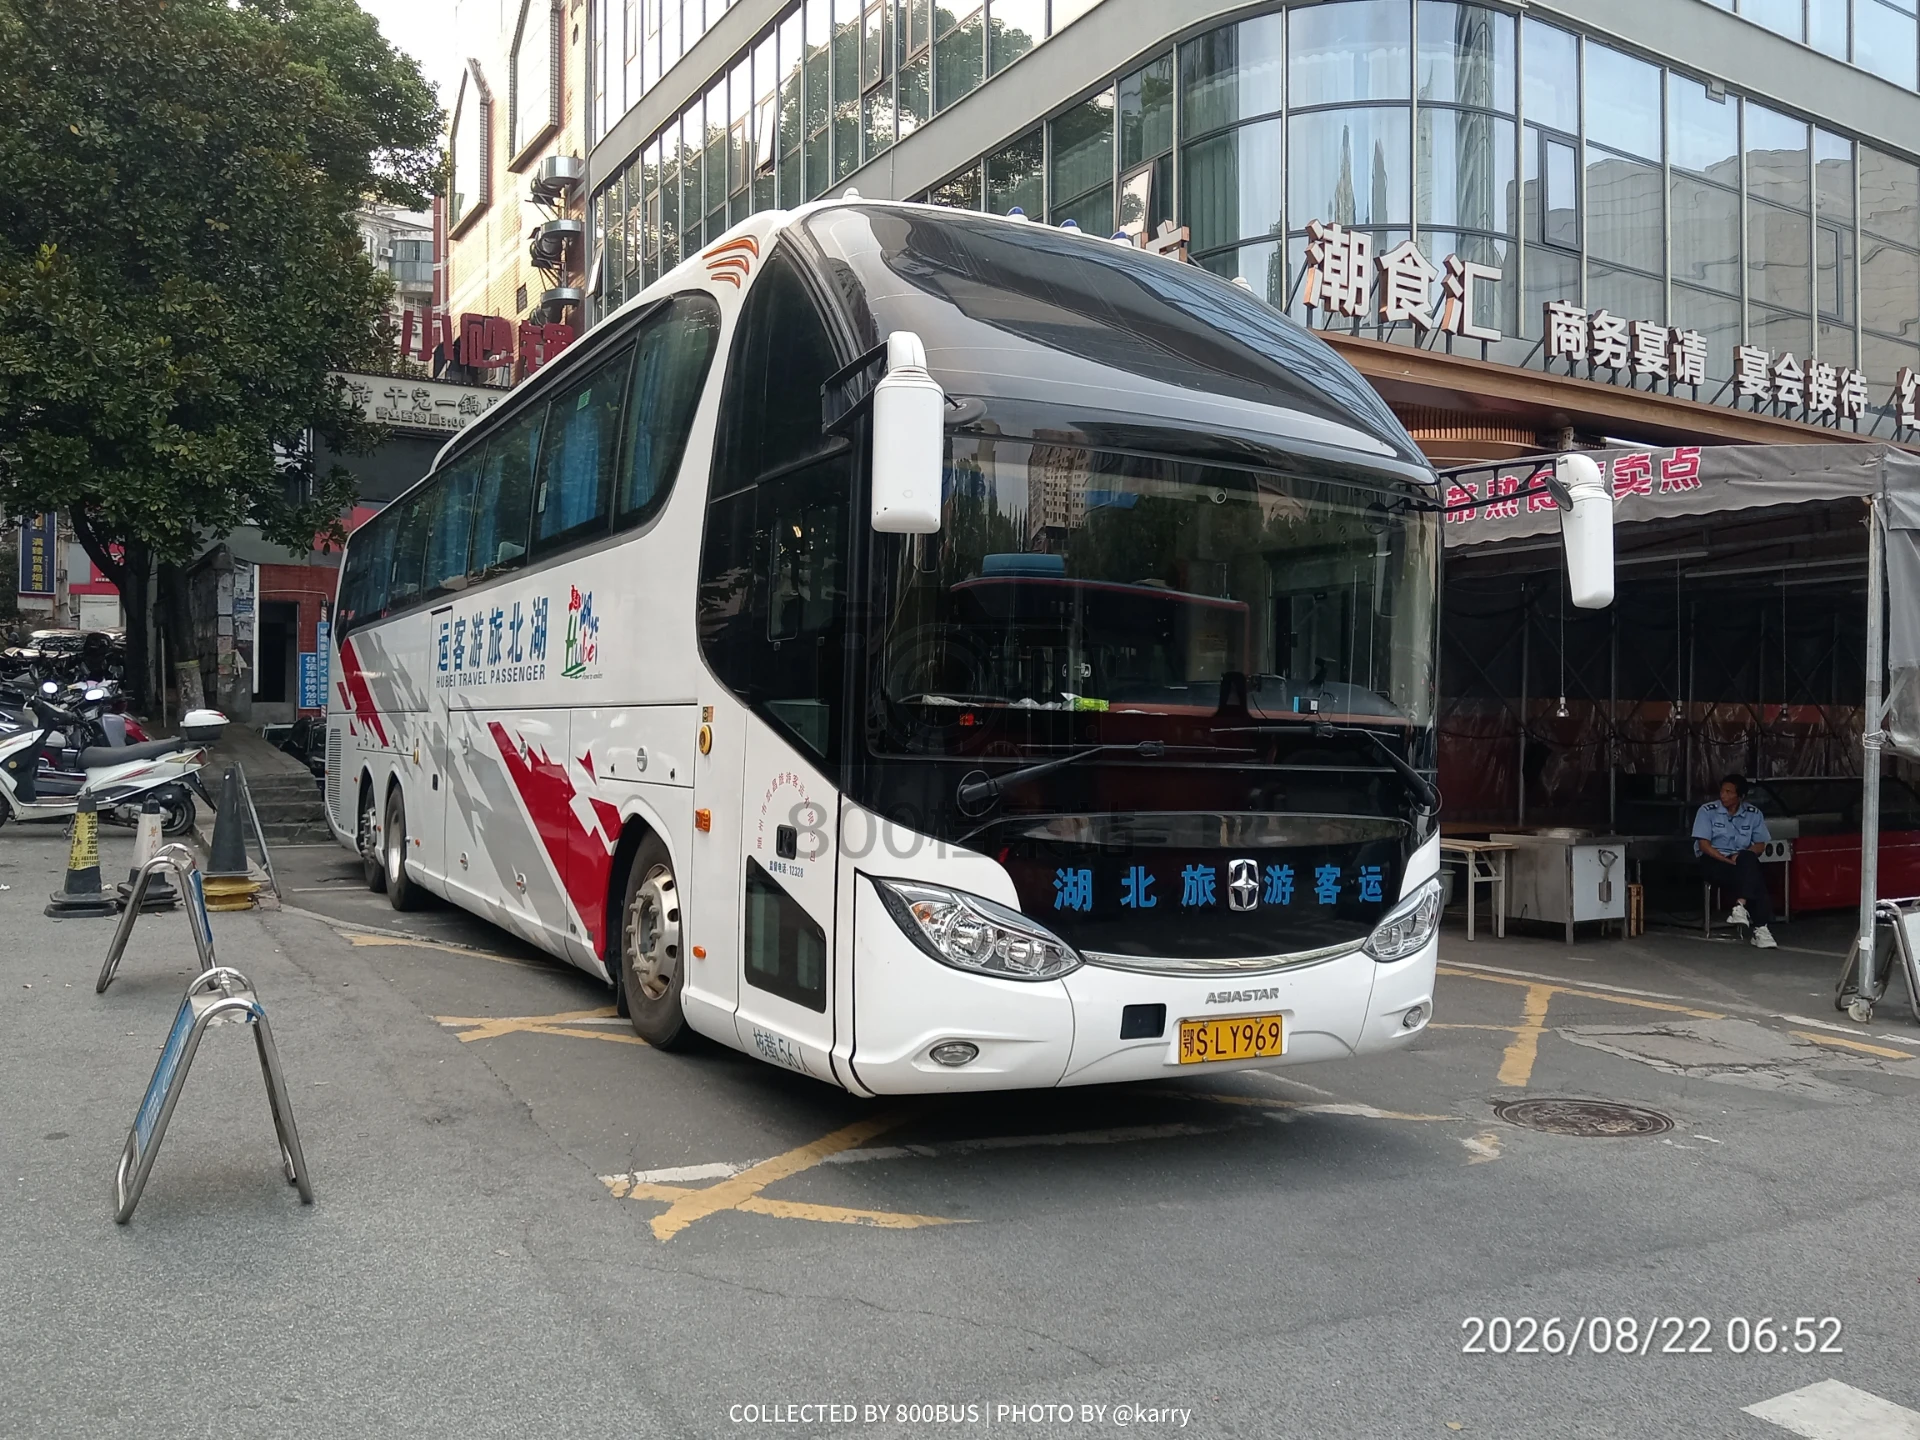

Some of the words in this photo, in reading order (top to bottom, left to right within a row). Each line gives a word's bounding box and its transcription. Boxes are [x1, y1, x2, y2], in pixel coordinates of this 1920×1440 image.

[1304, 219, 1502, 342] 潮食汇
[1546, 300, 1707, 386] 商务宴请
[1735, 345, 1868, 419] 宴会接待
[436, 674, 456, 689] HUBEI
[458, 670, 487, 687] TRAVEL
[490, 664, 546, 684] PASSENGER
[1053, 864, 1383, 912] 湖北旅游客运
[1205, 987, 1279, 1004] ASIASTAR
